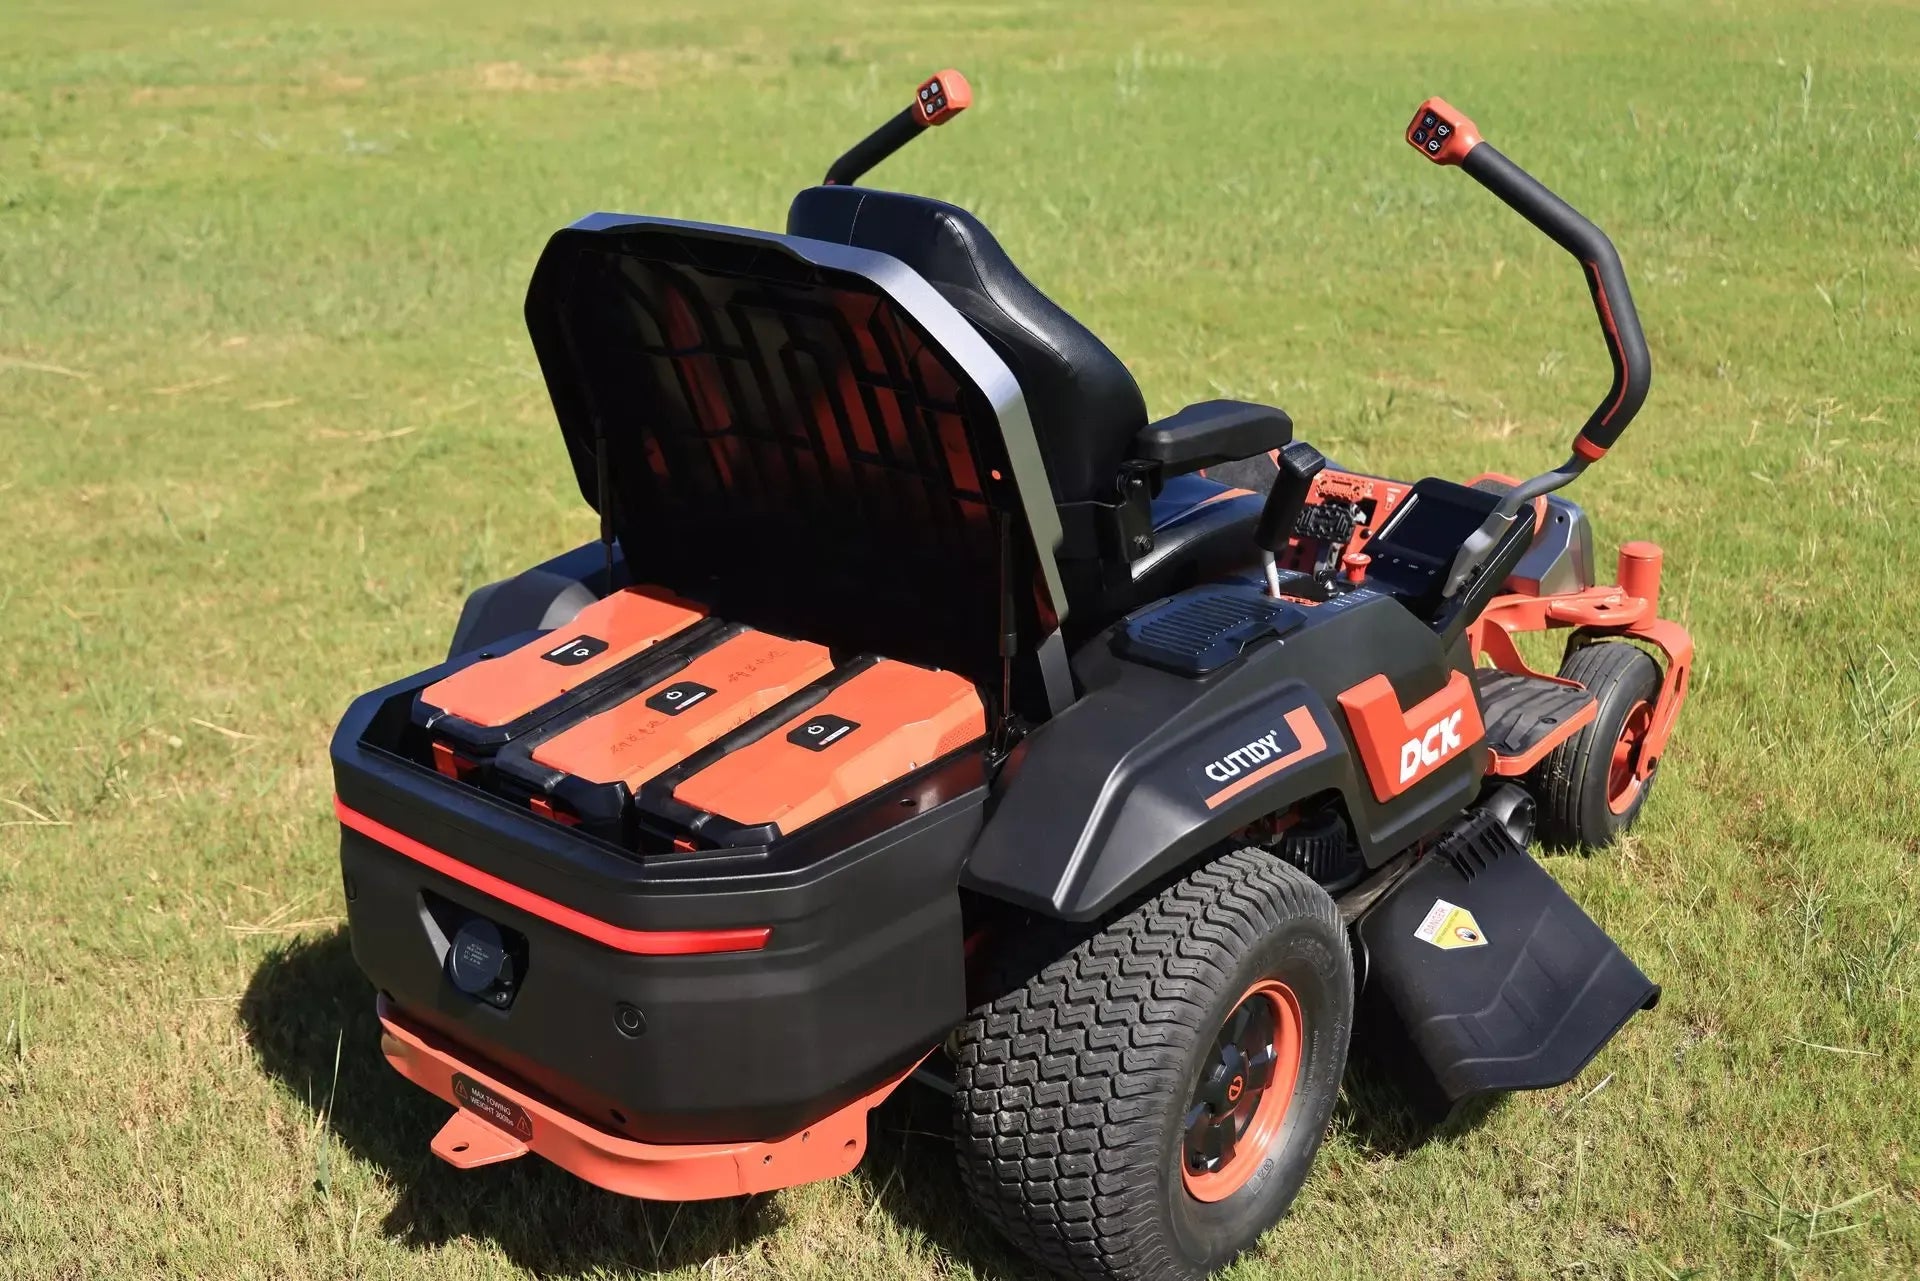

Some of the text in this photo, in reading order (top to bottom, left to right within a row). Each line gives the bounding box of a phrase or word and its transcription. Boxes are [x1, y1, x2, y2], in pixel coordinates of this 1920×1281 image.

[1204, 734, 1282, 782] CUTIDY
[1399, 709, 1462, 784] DCK
[1423, 907, 1446, 935] DANGER
[470, 1096, 494, 1115] WEIGHT
[471, 1087, 512, 1116] MAX TOWING
